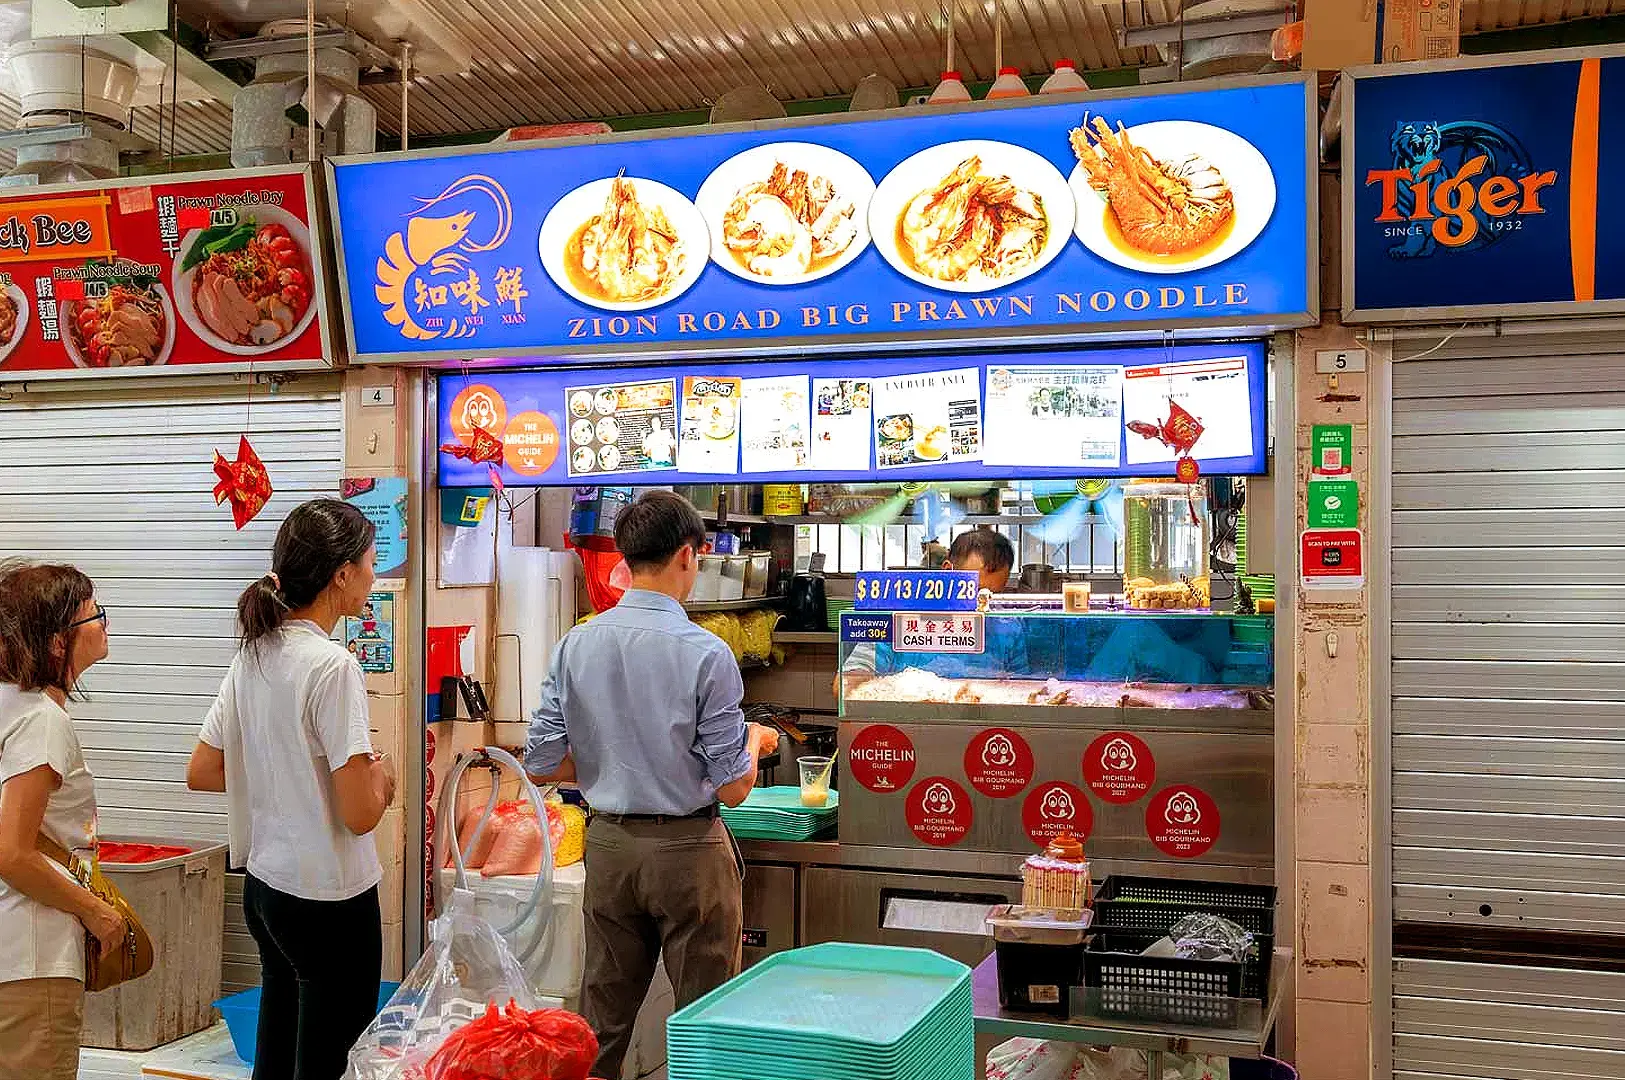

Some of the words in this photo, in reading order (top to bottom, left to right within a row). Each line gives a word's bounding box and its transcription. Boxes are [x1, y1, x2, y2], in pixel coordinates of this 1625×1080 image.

[178, 195, 214, 208] Prawn
[216, 190, 259, 206] Noodle
[261, 189, 284, 205] Dry
[1365, 155, 1558, 246] Tiger
[32, 214, 91, 245] Bee
[1384, 226, 1423, 238] SINCE
[1489, 220, 1523, 231] 1932
[53, 266, 88, 279] Prawn
[89, 263, 131, 278] Noodle
[132, 263, 161, 277] Soup
[568, 316, 658, 339] ZION
[678, 309, 782, 333] ROAD
[801, 304, 870, 328] BIG
[892, 295, 1036, 322] PRAWN
[1056, 283, 1250, 314] NOODLE
[425, 318, 444, 328] ZHI
[464, 316, 484, 326] WEI
[502, 313, 527, 325] XIAN
[1335, 355, 1347, 369] 5
[372, 390, 382, 402] 4
[524, 423, 537, 431] THE
[504, 433, 554, 444] MICHELIN
[517, 447, 542, 456] GUIDE
[848, 618, 889, 630] Takeaway
[906, 620, 973, 634] 現金交易
[850, 629, 867, 638] add
[903, 635, 933, 646] CASH
[938, 636, 976, 647] TERMS
[850, 749, 915, 762] MICHELIN
[872, 762, 893, 770] GUIDE
[973, 776, 985, 784] BIB
[1102, 774, 1136, 782] MICHELIN
[1092, 781, 1105, 789] BIB
[923, 818, 955, 826] MICHELIN
[1041, 823, 1074, 831] MICHELIN
[914, 824, 926, 832] BIB
[1165, 828, 1200, 836] MICHELIN
[1155, 835, 1168, 843] BIB
